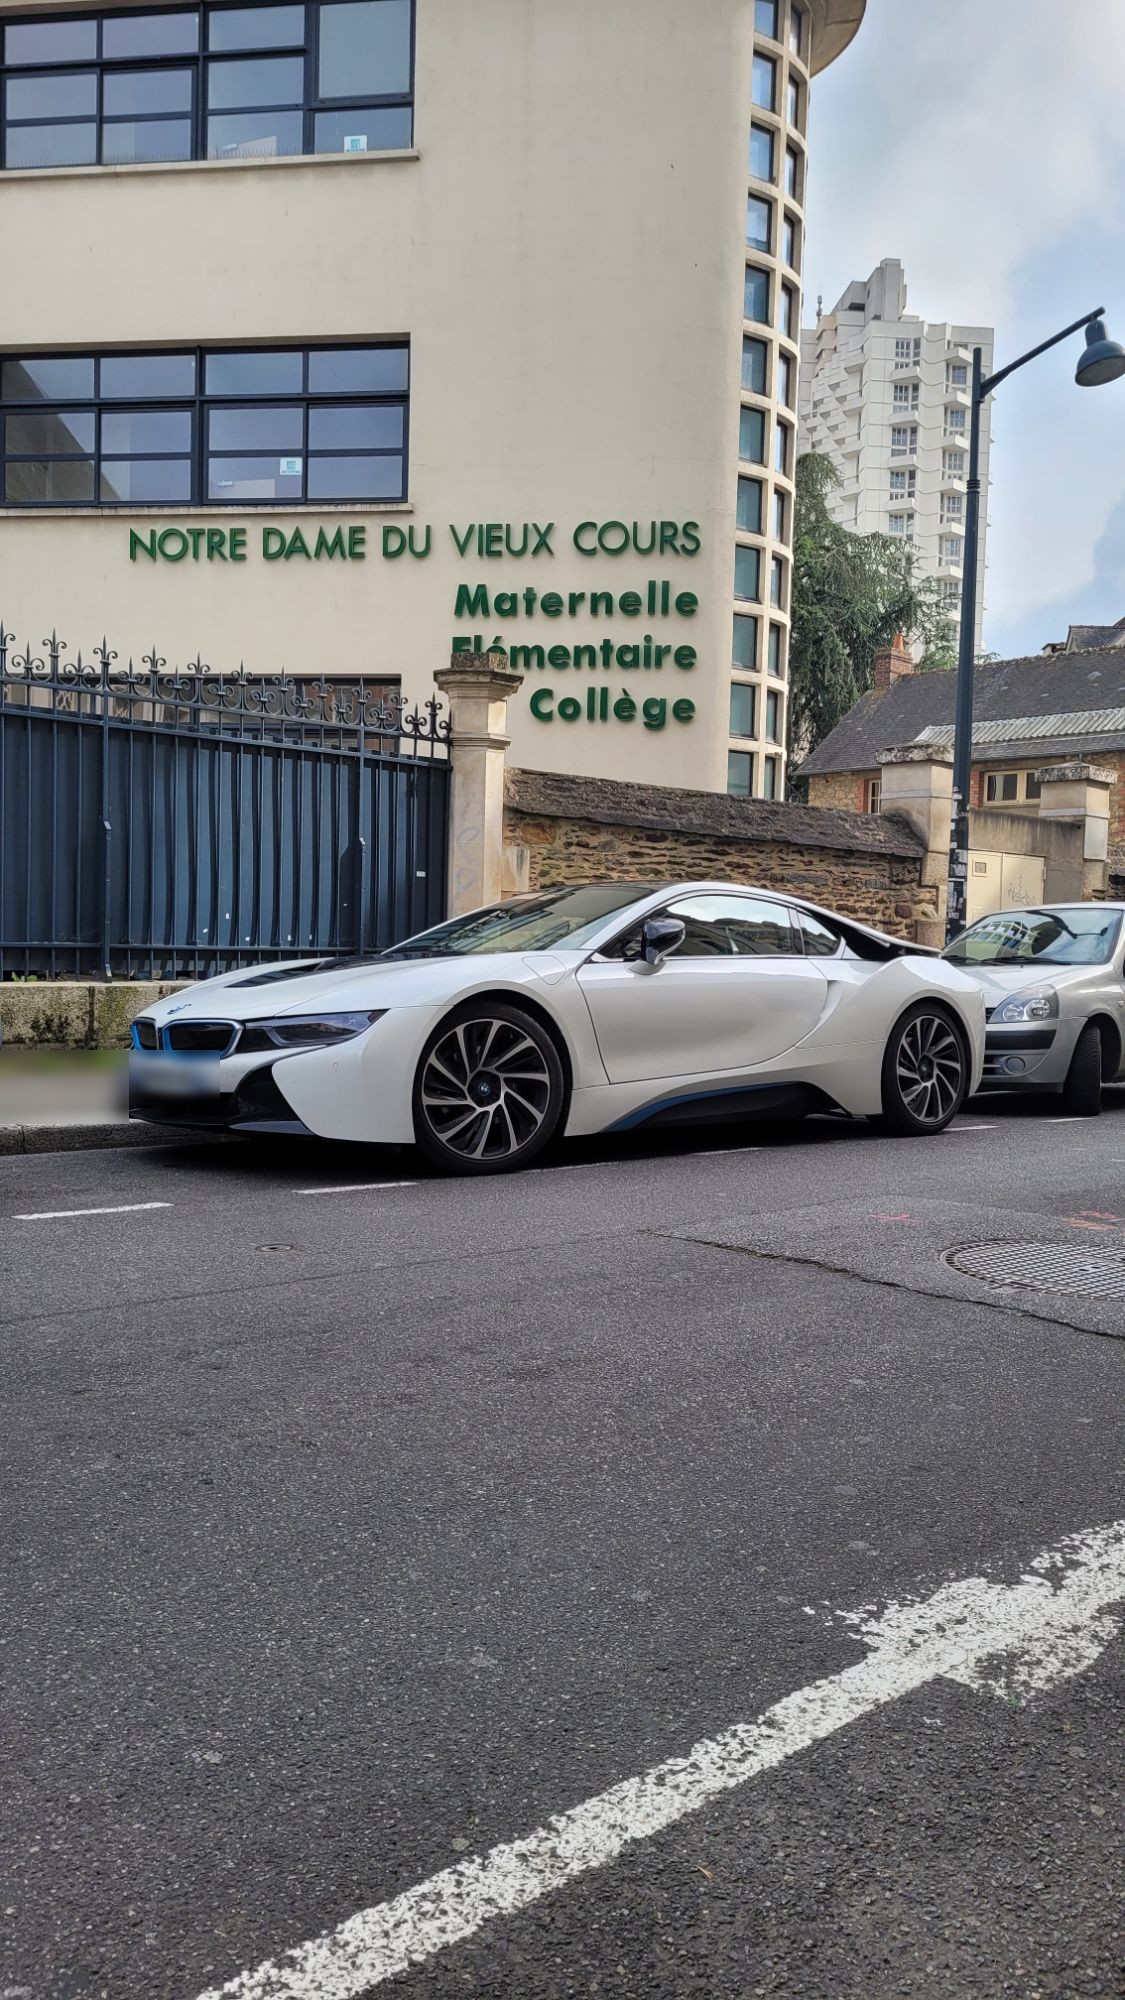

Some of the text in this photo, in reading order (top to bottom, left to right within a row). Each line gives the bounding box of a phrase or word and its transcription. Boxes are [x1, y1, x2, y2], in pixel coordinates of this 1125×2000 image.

[129, 520, 701, 562] NOTRE DAME DU VIEUX COURS
[454, 580, 699, 618] Maternelle
[530, 687, 696, 731] Collège
